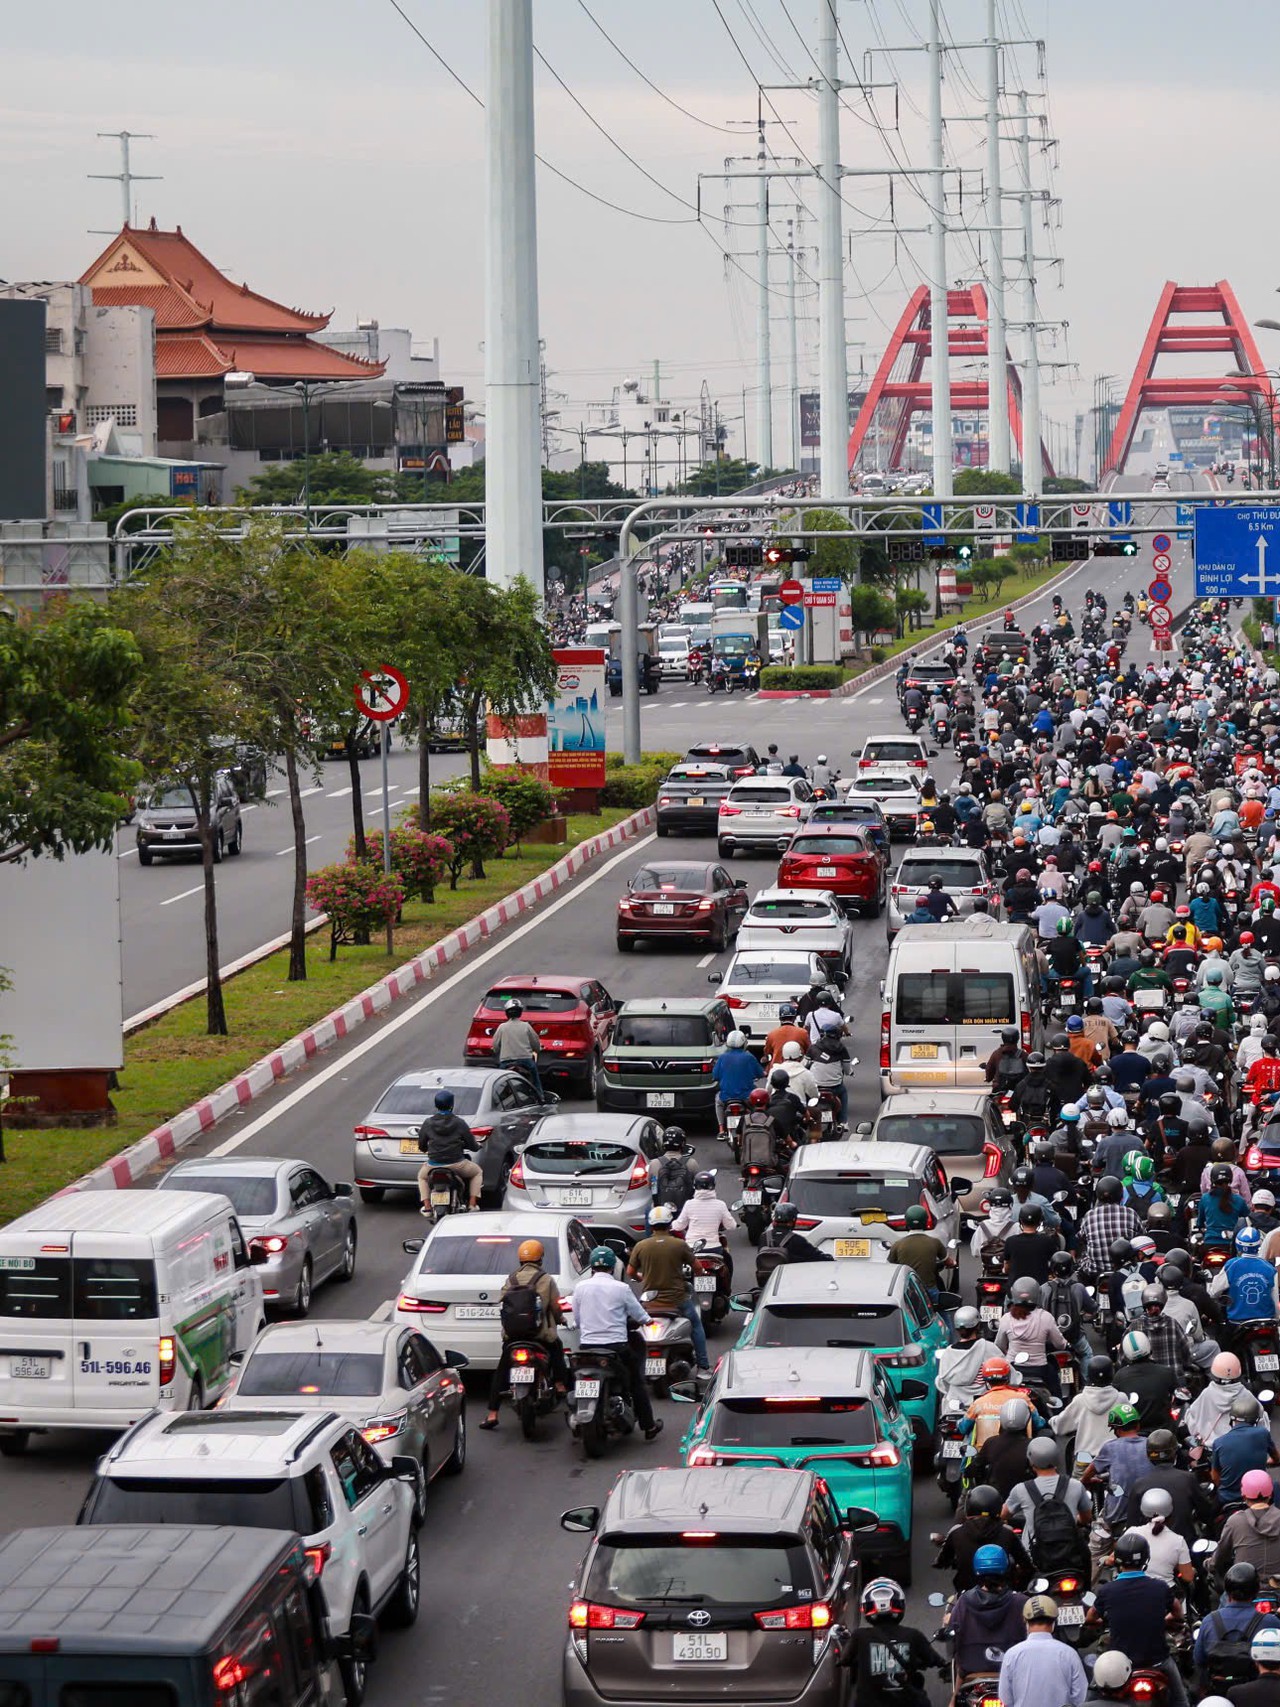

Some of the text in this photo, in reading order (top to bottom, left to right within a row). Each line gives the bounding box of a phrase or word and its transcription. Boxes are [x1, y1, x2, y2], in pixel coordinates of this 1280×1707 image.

[1237, 513, 1251, 521] CHỢ
[1252, 511, 1268, 519] THỦ
[1248, 523, 1274, 531] 6.5 Km
[1212, 563, 1225, 571] DÂN
[1200, 573, 1233, 584] BÌNH LỢI
[1205, 585, 1219, 594] 500
[816, 595, 827, 604] QUAN
[22, 1357, 38, 1366] 51L
[15, 1367, 46, 1376] 596.46
[81, 1360, 151, 1374] 51L-596.46
[689, 1635, 711, 1646] 51L
[679, 1647, 721, 1659] 430.90
